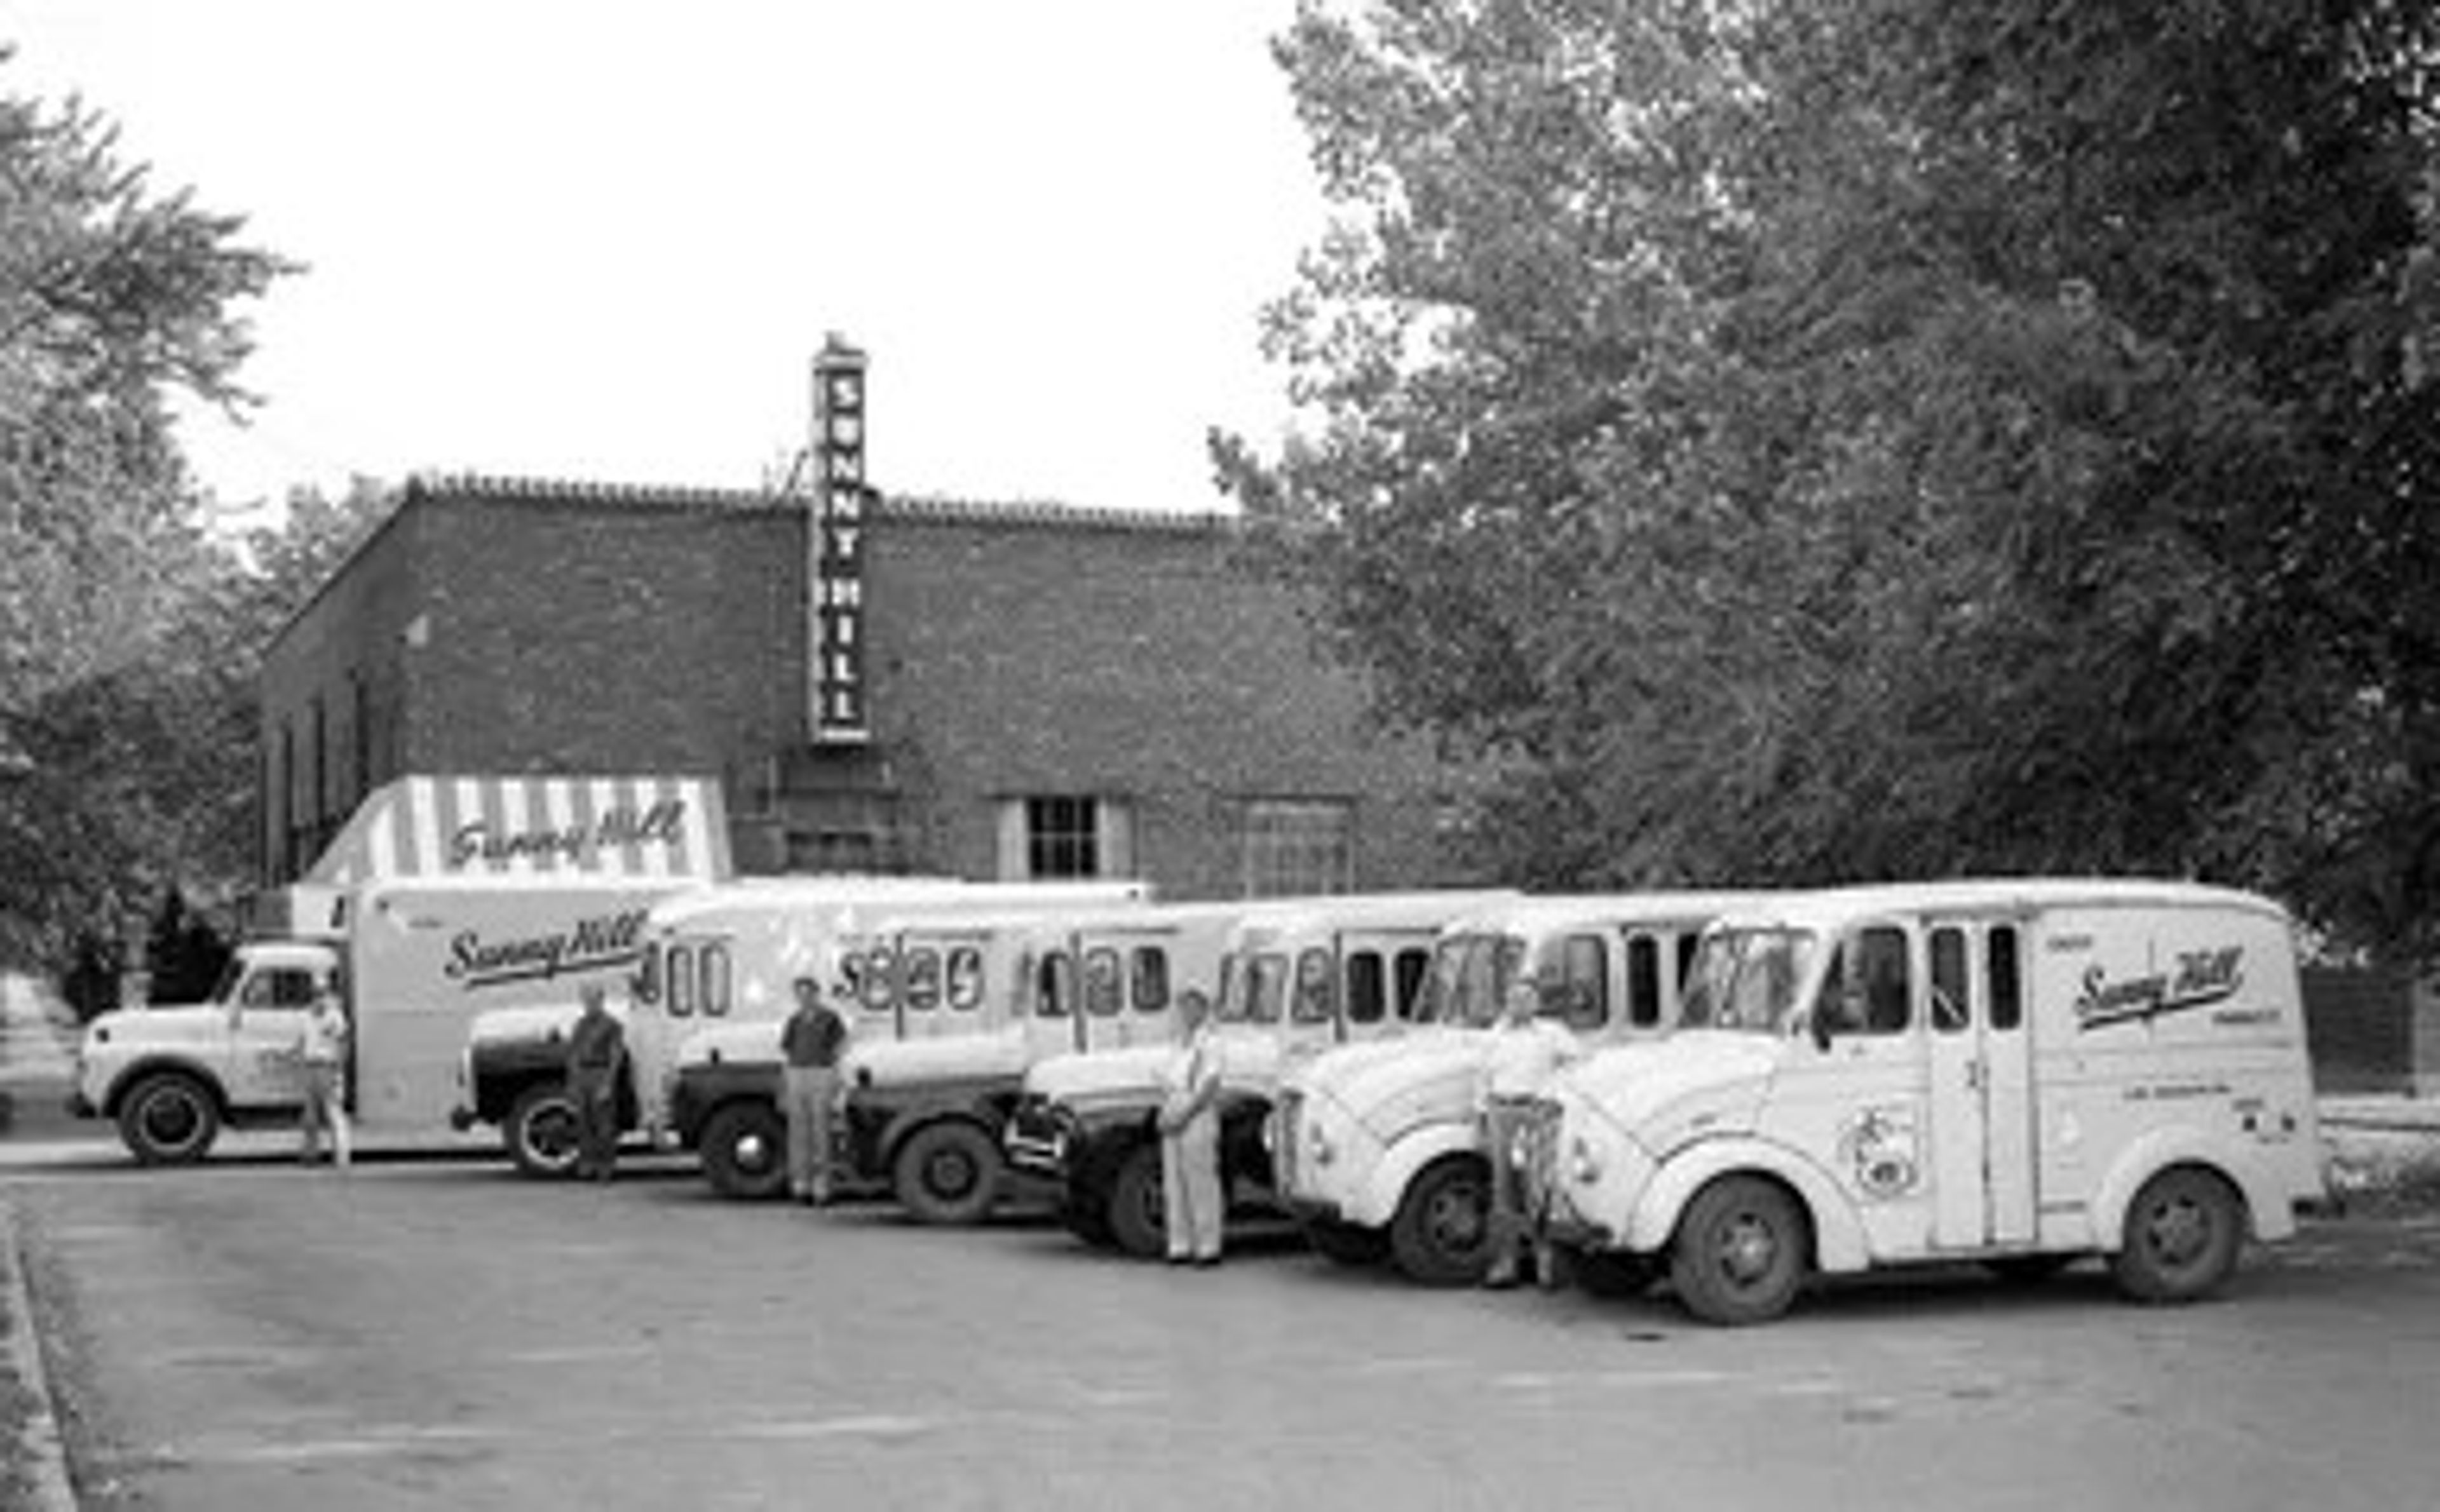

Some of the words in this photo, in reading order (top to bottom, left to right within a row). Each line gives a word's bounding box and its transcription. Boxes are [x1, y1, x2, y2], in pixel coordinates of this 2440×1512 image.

[831, 379, 861, 557] SUNNY
[830, 577, 860, 719] HILL
[597, 800, 686, 846] Hill
[444, 931, 567, 980] Sunny
[570, 908, 649, 954] Hill
[2073, 964, 2167, 1020] Sunny
[2173, 944, 2245, 994] Hill
